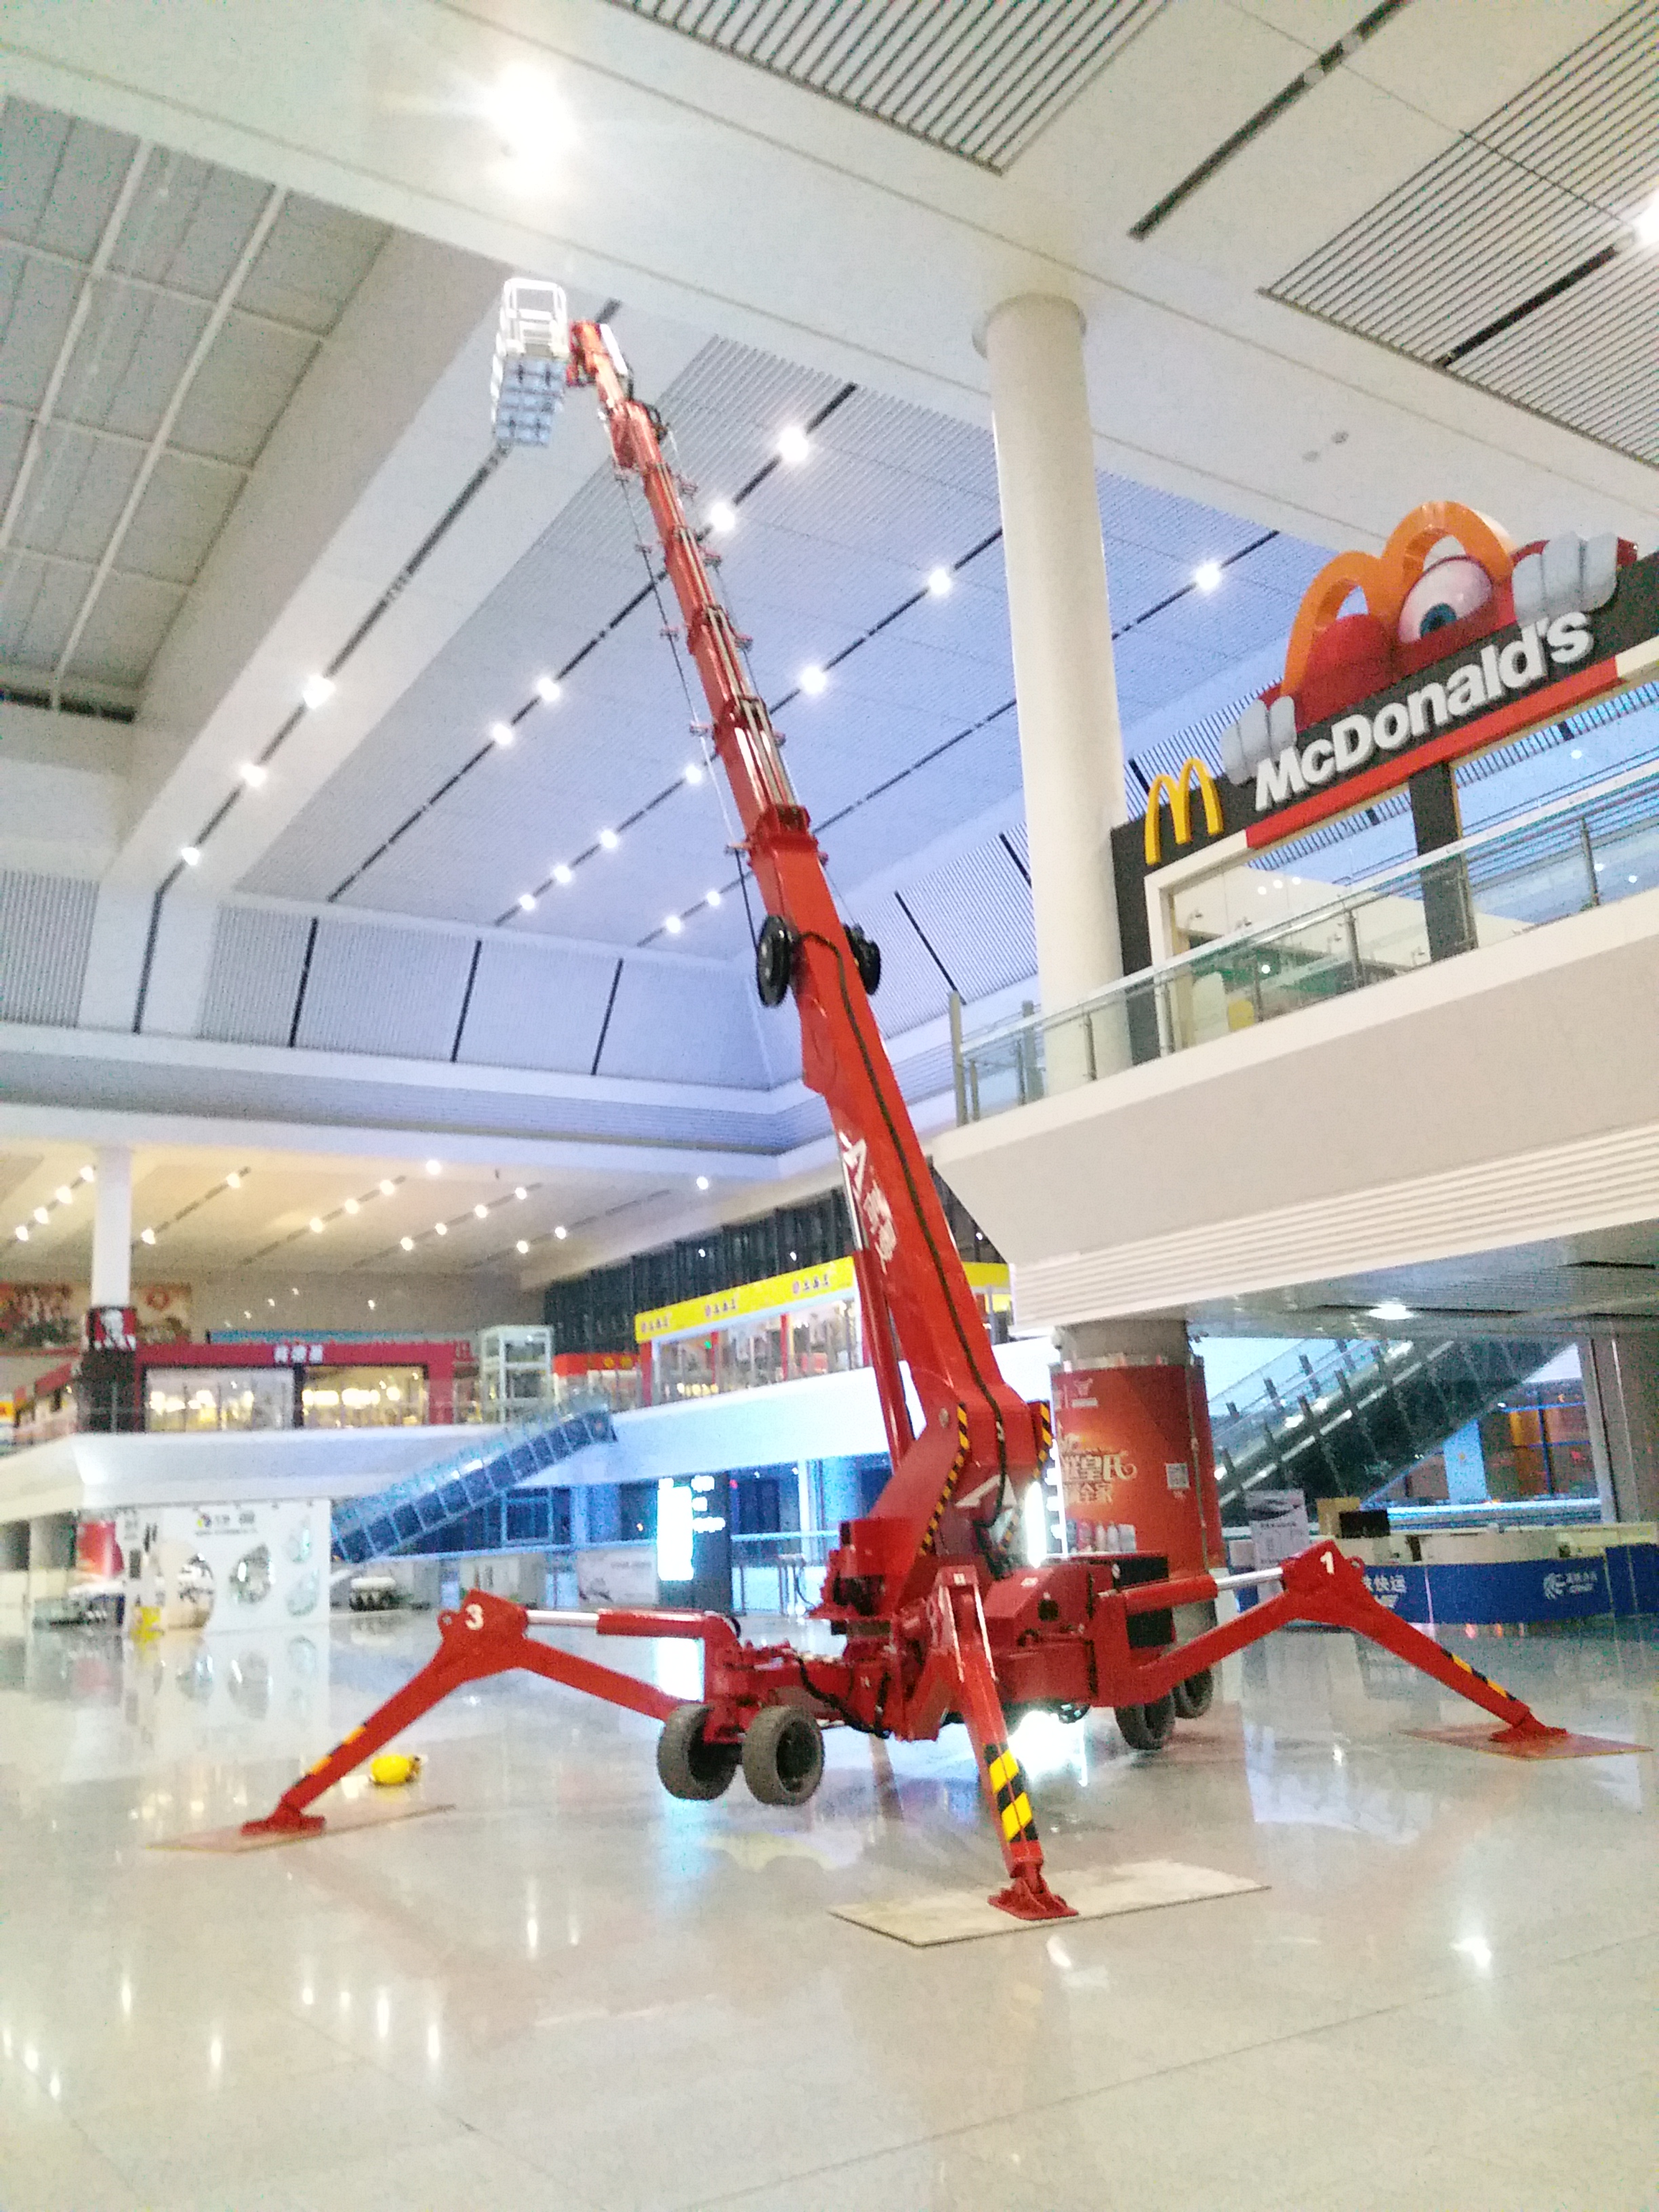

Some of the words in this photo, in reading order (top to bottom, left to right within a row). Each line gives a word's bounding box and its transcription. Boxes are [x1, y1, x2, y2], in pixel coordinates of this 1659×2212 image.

[1255, 611, 1595, 812] McDonald's
[1319, 1551, 1335, 1576] 1
[465, 1603, 484, 1631] 3
